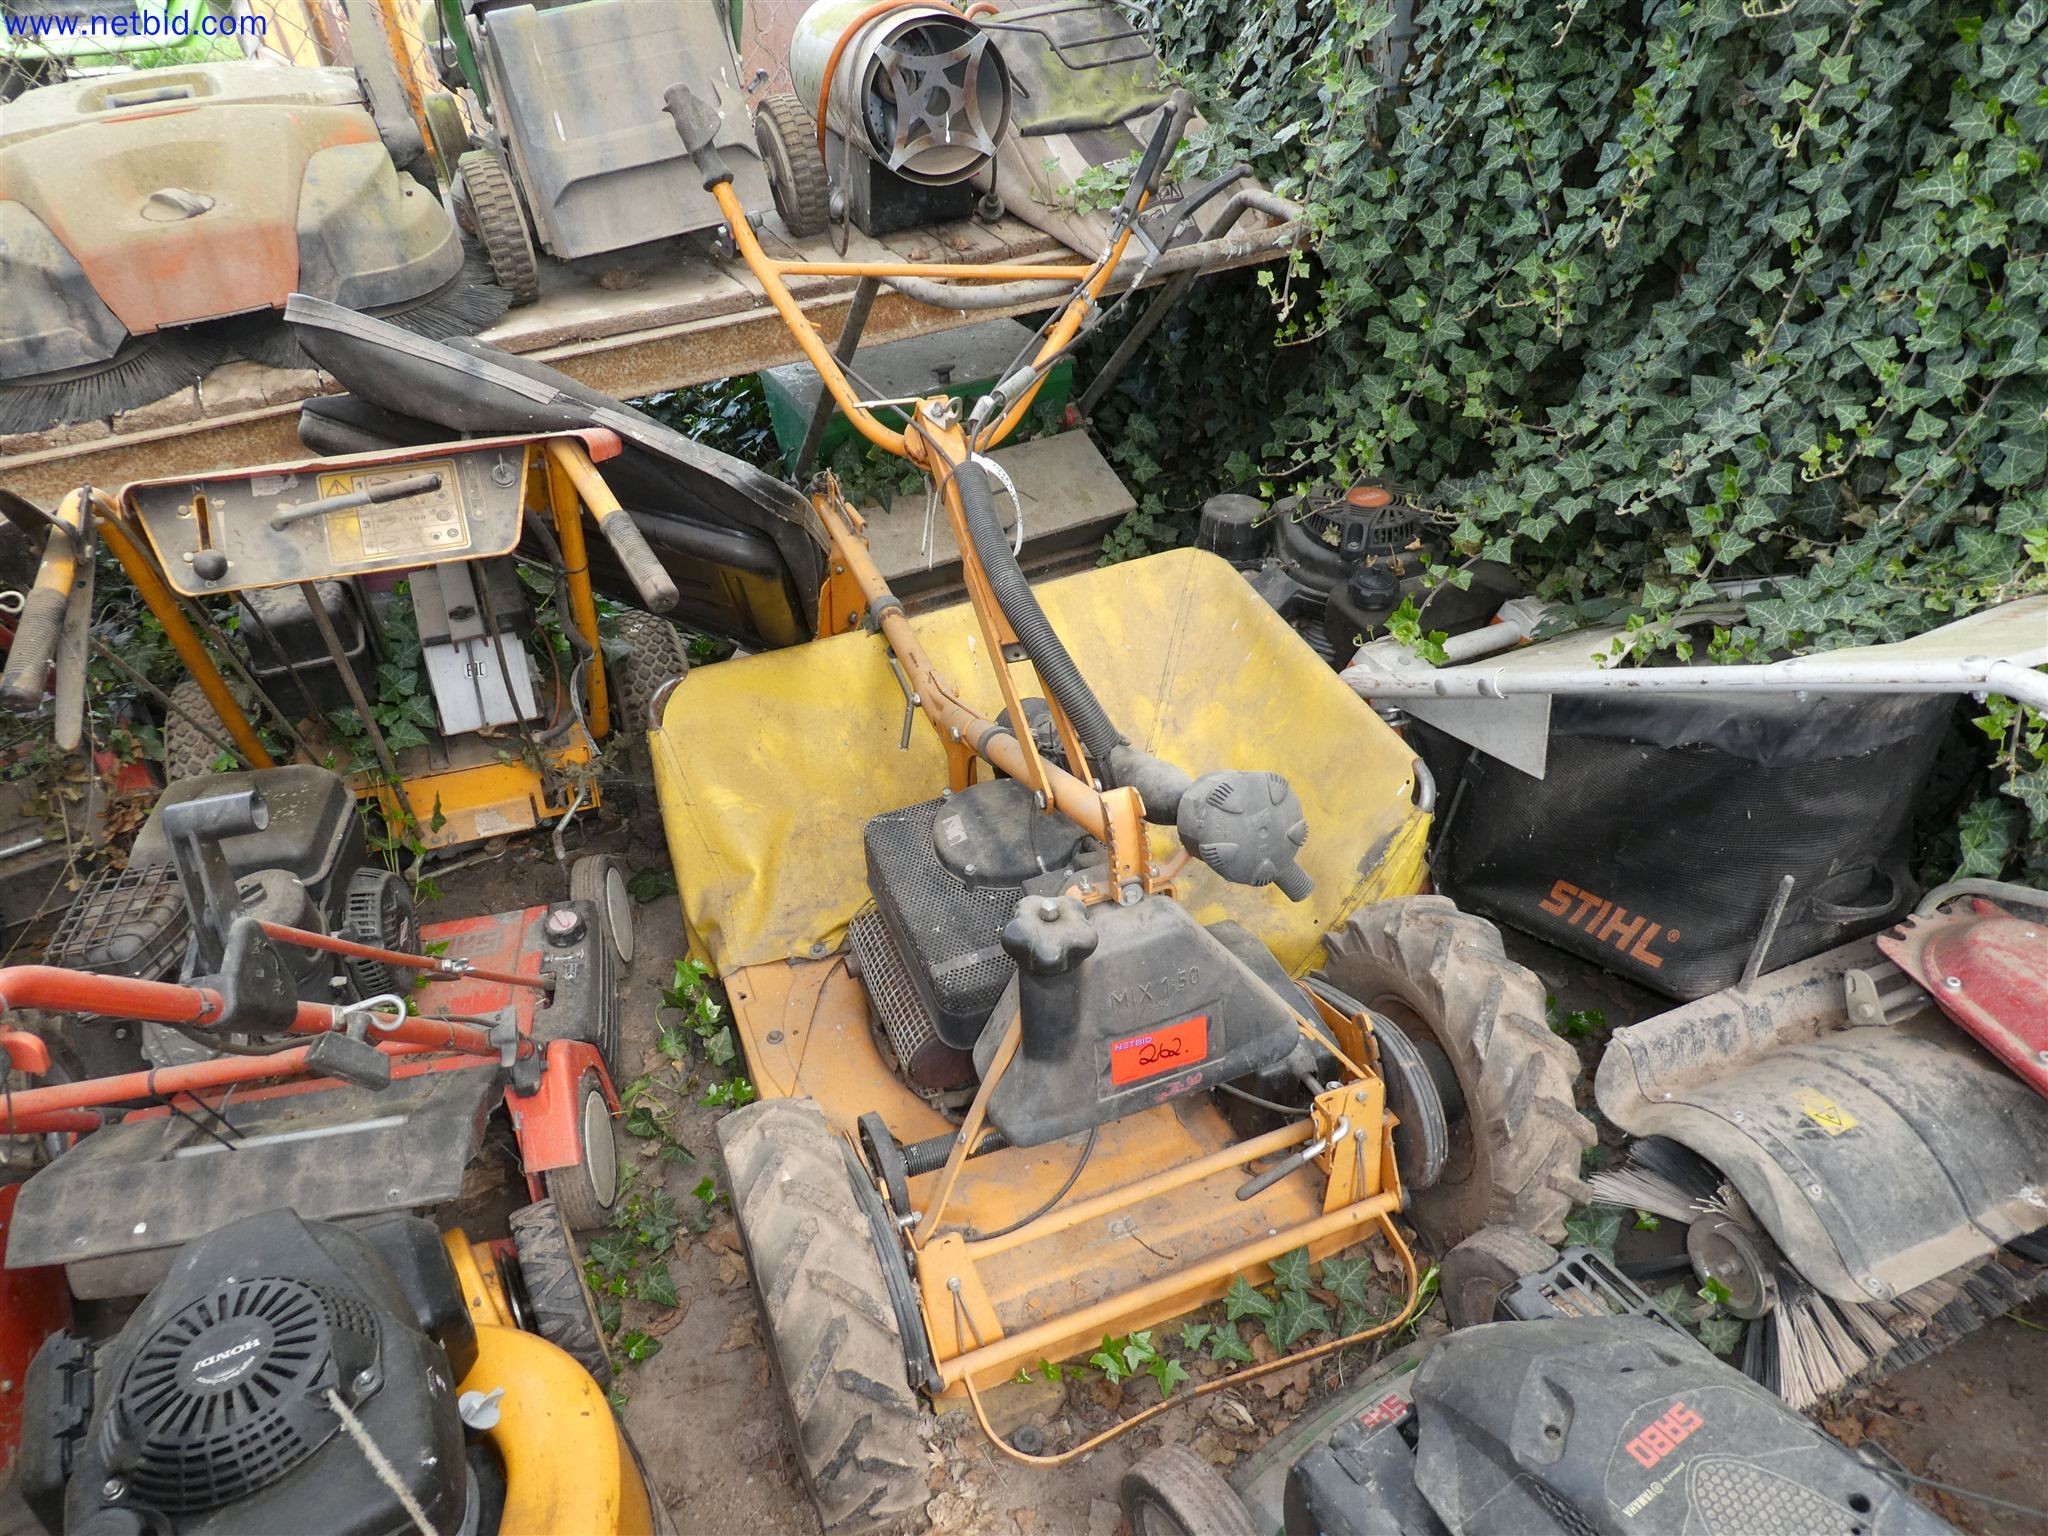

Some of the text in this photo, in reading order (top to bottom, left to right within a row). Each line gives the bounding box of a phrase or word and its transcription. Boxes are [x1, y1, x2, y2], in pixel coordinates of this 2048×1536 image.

[1538, 879, 1664, 969] STIHL
[1108, 982, 1153, 1014] MIX
[1114, 1036, 1153, 1052] NETBID
[1625, 1401, 1704, 1469] SABO
[1622, 1488, 1657, 1518] YAMAHA
